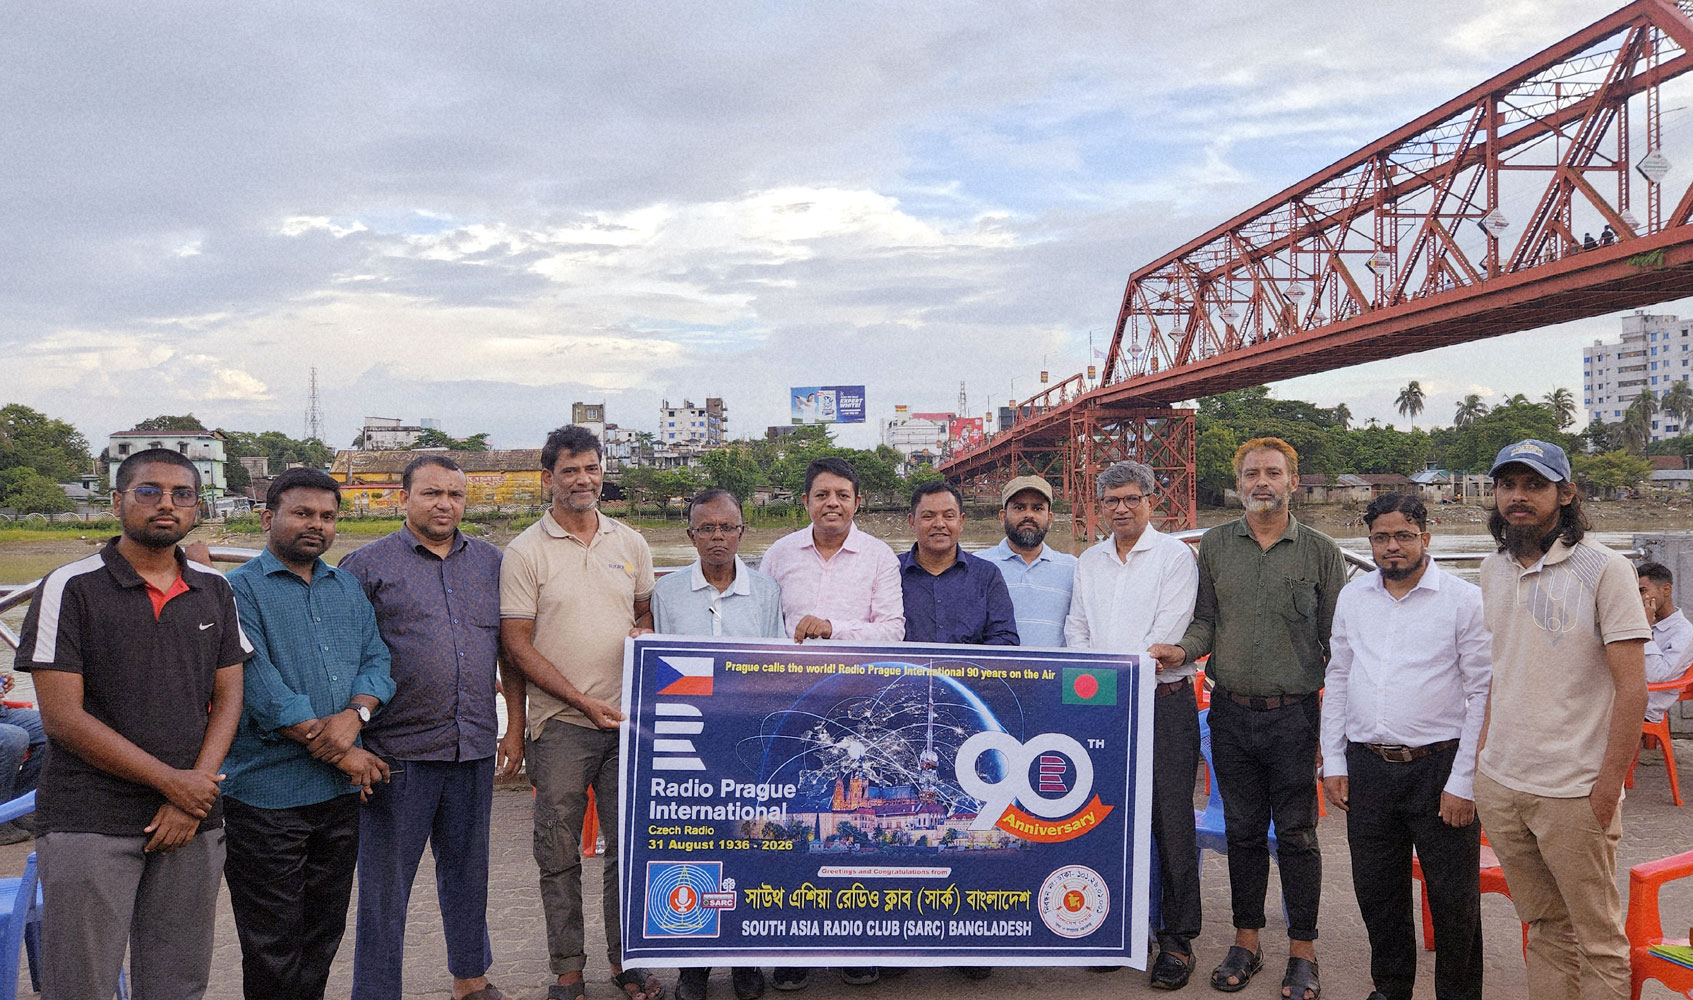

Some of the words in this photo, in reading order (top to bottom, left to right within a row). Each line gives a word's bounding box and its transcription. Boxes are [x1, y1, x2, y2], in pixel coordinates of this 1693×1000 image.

[725, 661, 760, 675] Prague
[762, 662, 786, 673] calls
[787, 662, 803, 674] the
[806, 663, 836, 674] world!
[838, 664, 866, 675] Radio
[867, 664, 901, 677] Prague
[903, 665, 965, 677] International
[966, 667, 979, 678] 90
[981, 668, 1008, 681] years
[1009, 670, 1021, 679] on
[1023, 668, 1038, 680] the
[1042, 669, 1056, 680] Air
[650, 777, 714, 798] Radio
[720, 778, 796, 802] Prague
[955, 730, 1094, 832] 90
[1087, 738, 1105, 749] TH
[649, 800, 787, 821] International
[648, 825, 681, 836] Czech
[684, 825, 715, 836] Radio
[1002, 811, 1096, 836] Anniversary
[648, 839, 663, 850] 31
[668, 839, 714, 852] August
[719, 840, 750, 850] 1936
[761, 840, 793, 850] 2026
[821, 868, 857, 876] Greetings
[873, 868, 929, 876] Congratulations
[744, 882, 785, 910] সাউথ
[788, 881, 832, 910] এশিয়া
[836, 882, 879, 910] রেডিও
[883, 887, 913, 912] ক্লাব
[917, 882, 961, 915] (সার্ক)
[965, 888, 1032, 912] বাংলাদেশ
[741, 920, 786, 936] SOUTH
[789, 920, 820, 936] ASIA
[823, 920, 863, 936] RADIO
[866, 920, 900, 936] CLUB
[903, 920, 945, 940] (SARC)
[949, 920, 1032, 936] BANGLADESH
